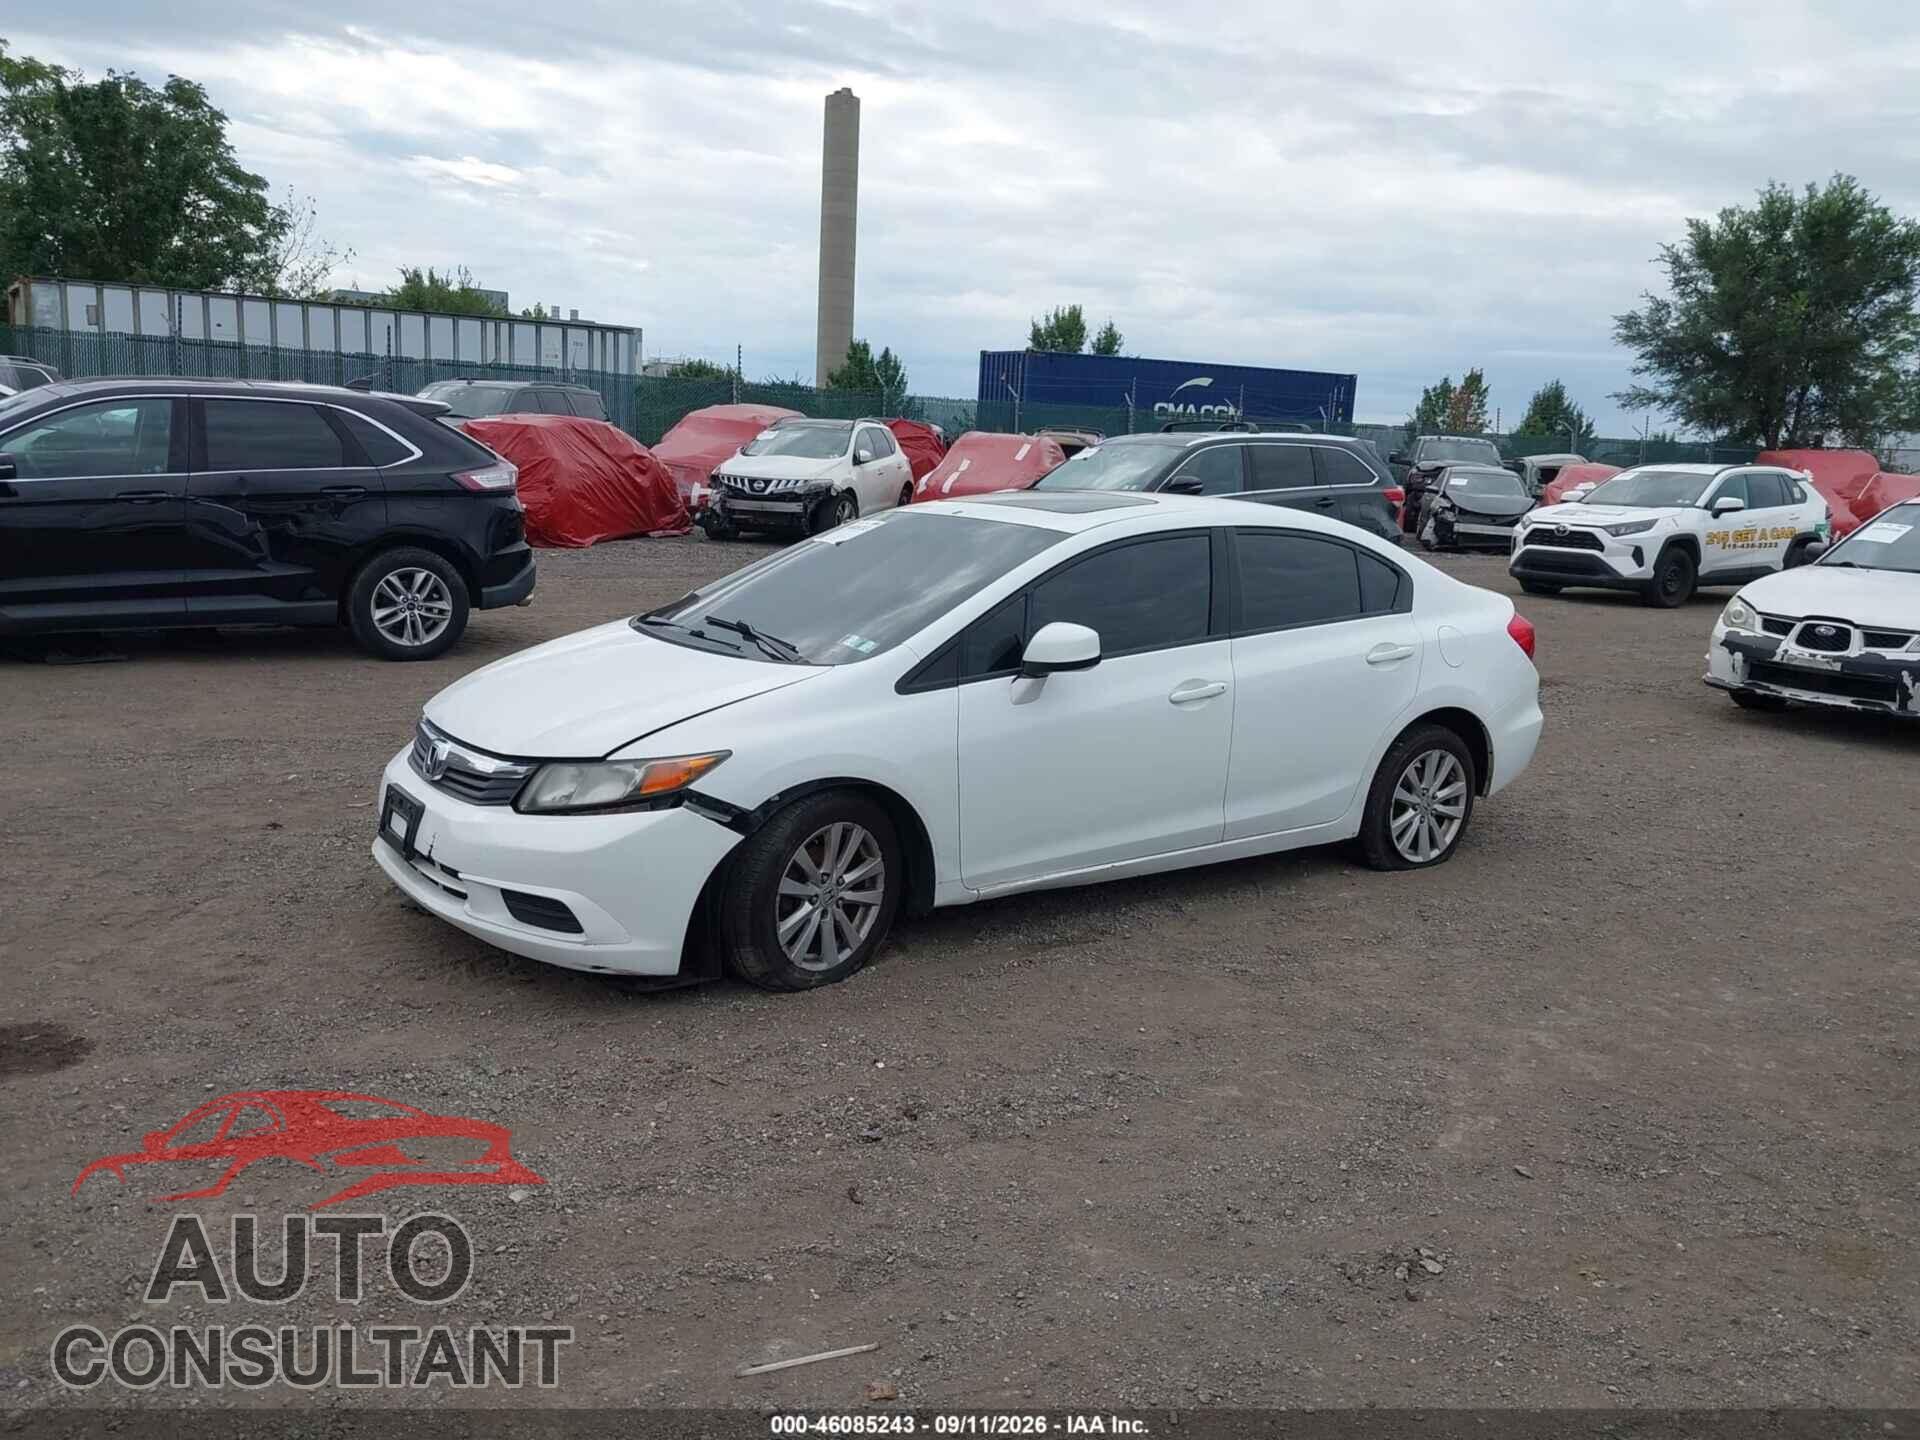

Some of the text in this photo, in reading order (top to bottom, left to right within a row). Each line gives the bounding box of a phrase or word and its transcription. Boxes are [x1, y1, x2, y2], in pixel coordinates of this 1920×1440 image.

[1154, 402, 1196, 418] CMA
[1731, 528, 1758, 543] GET
[1760, 527, 1769, 541] A
